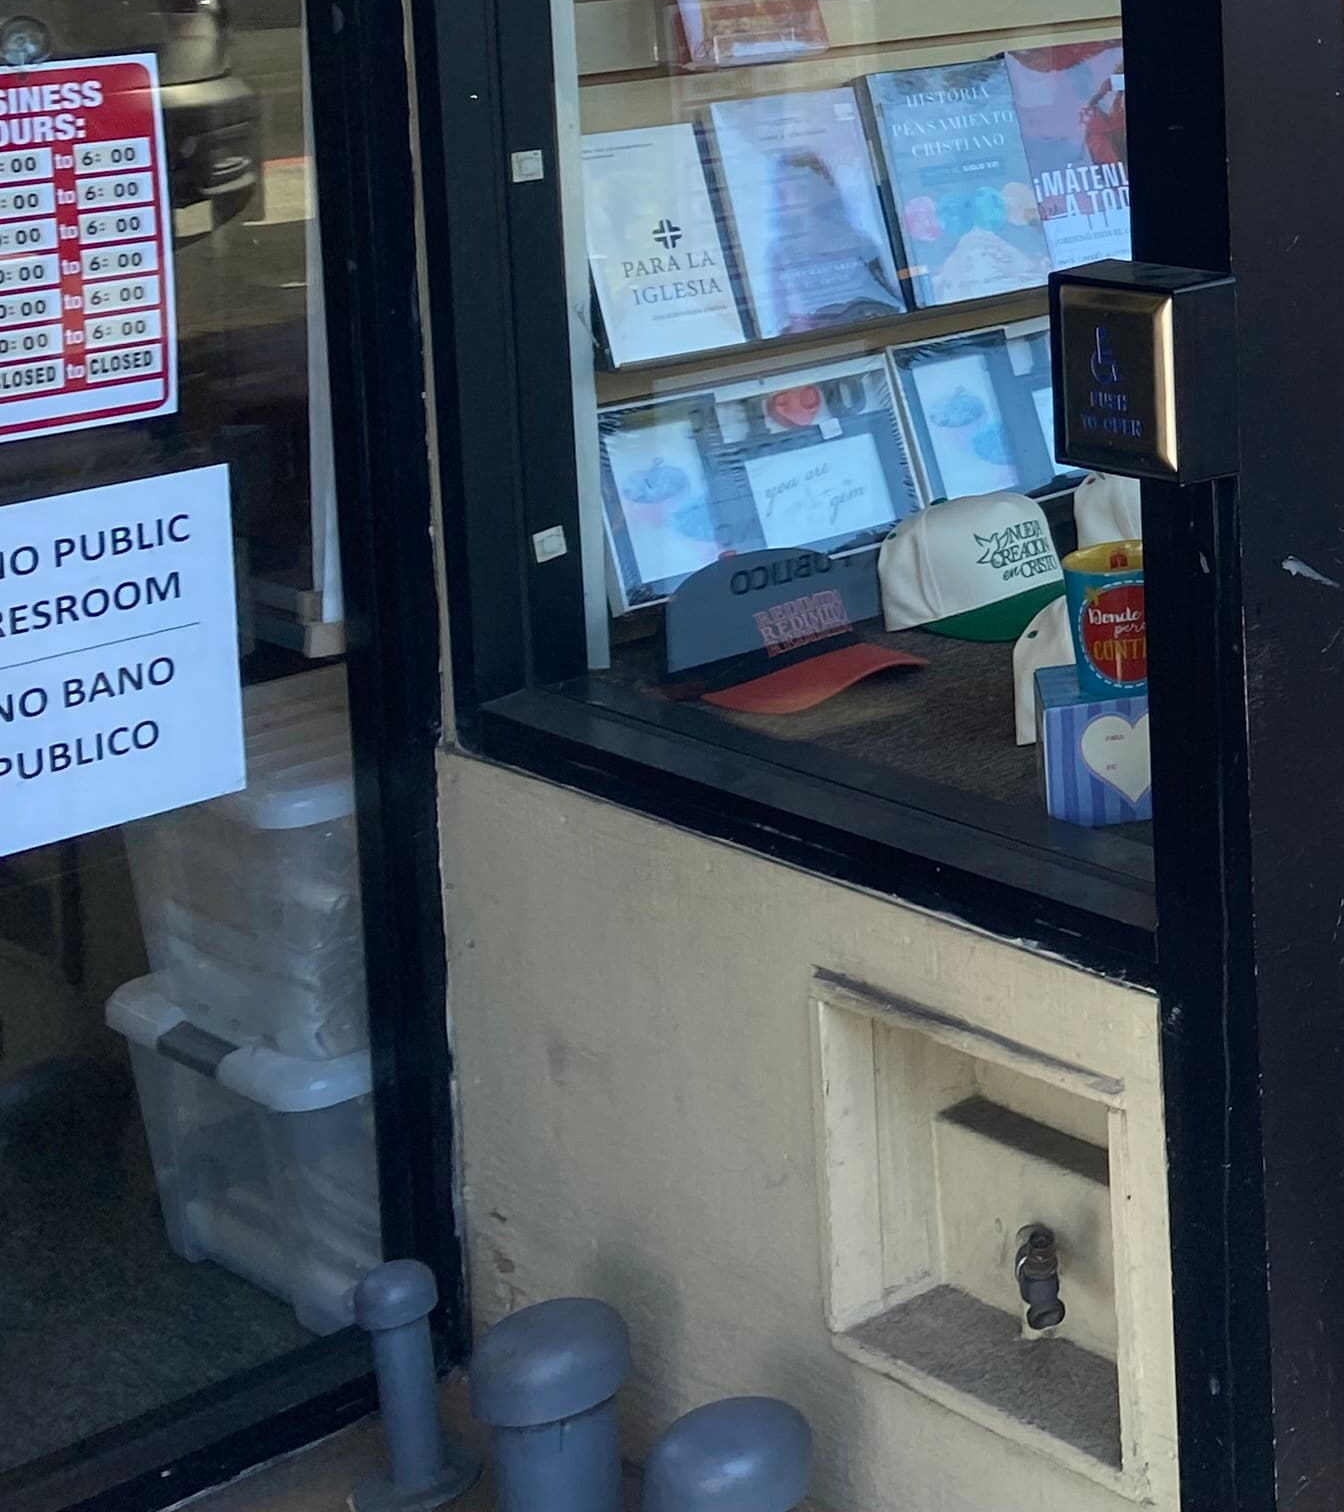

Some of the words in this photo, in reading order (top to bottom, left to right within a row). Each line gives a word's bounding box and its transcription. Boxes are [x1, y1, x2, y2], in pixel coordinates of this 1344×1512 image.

[906, 86, 990, 108] HISTORIA
[892, 109, 1013, 137] PENSAMIENTO
[911, 134, 1004, 159] CRISTIANO
[55, 154, 73, 169] to
[57, 189, 75, 204] to
[59, 224, 78, 239] to
[61, 260, 80, 275] to
[622, 253, 680, 278] PARA
[688, 250, 716, 269] LA
[64, 295, 82, 310] to
[633, 278, 723, 306] IGLESIA
[65, 330, 83, 345] to
[0, 366, 56, 388] LOSED
[67, 364, 85, 379] to
[89, 350, 153, 375] CLOSED
[1090, 392, 1127, 411] PUSH
[1081, 414, 1097, 431] TO
[1104, 417, 1143, 437] OPEN
[54, 514, 190, 568] PUBLIC
[1003, 566, 1021, 581] en
[1021, 555, 1057, 578] CRISTO
[1088, 607, 1140, 625] Donde
[63, 657, 175, 708] BANO
